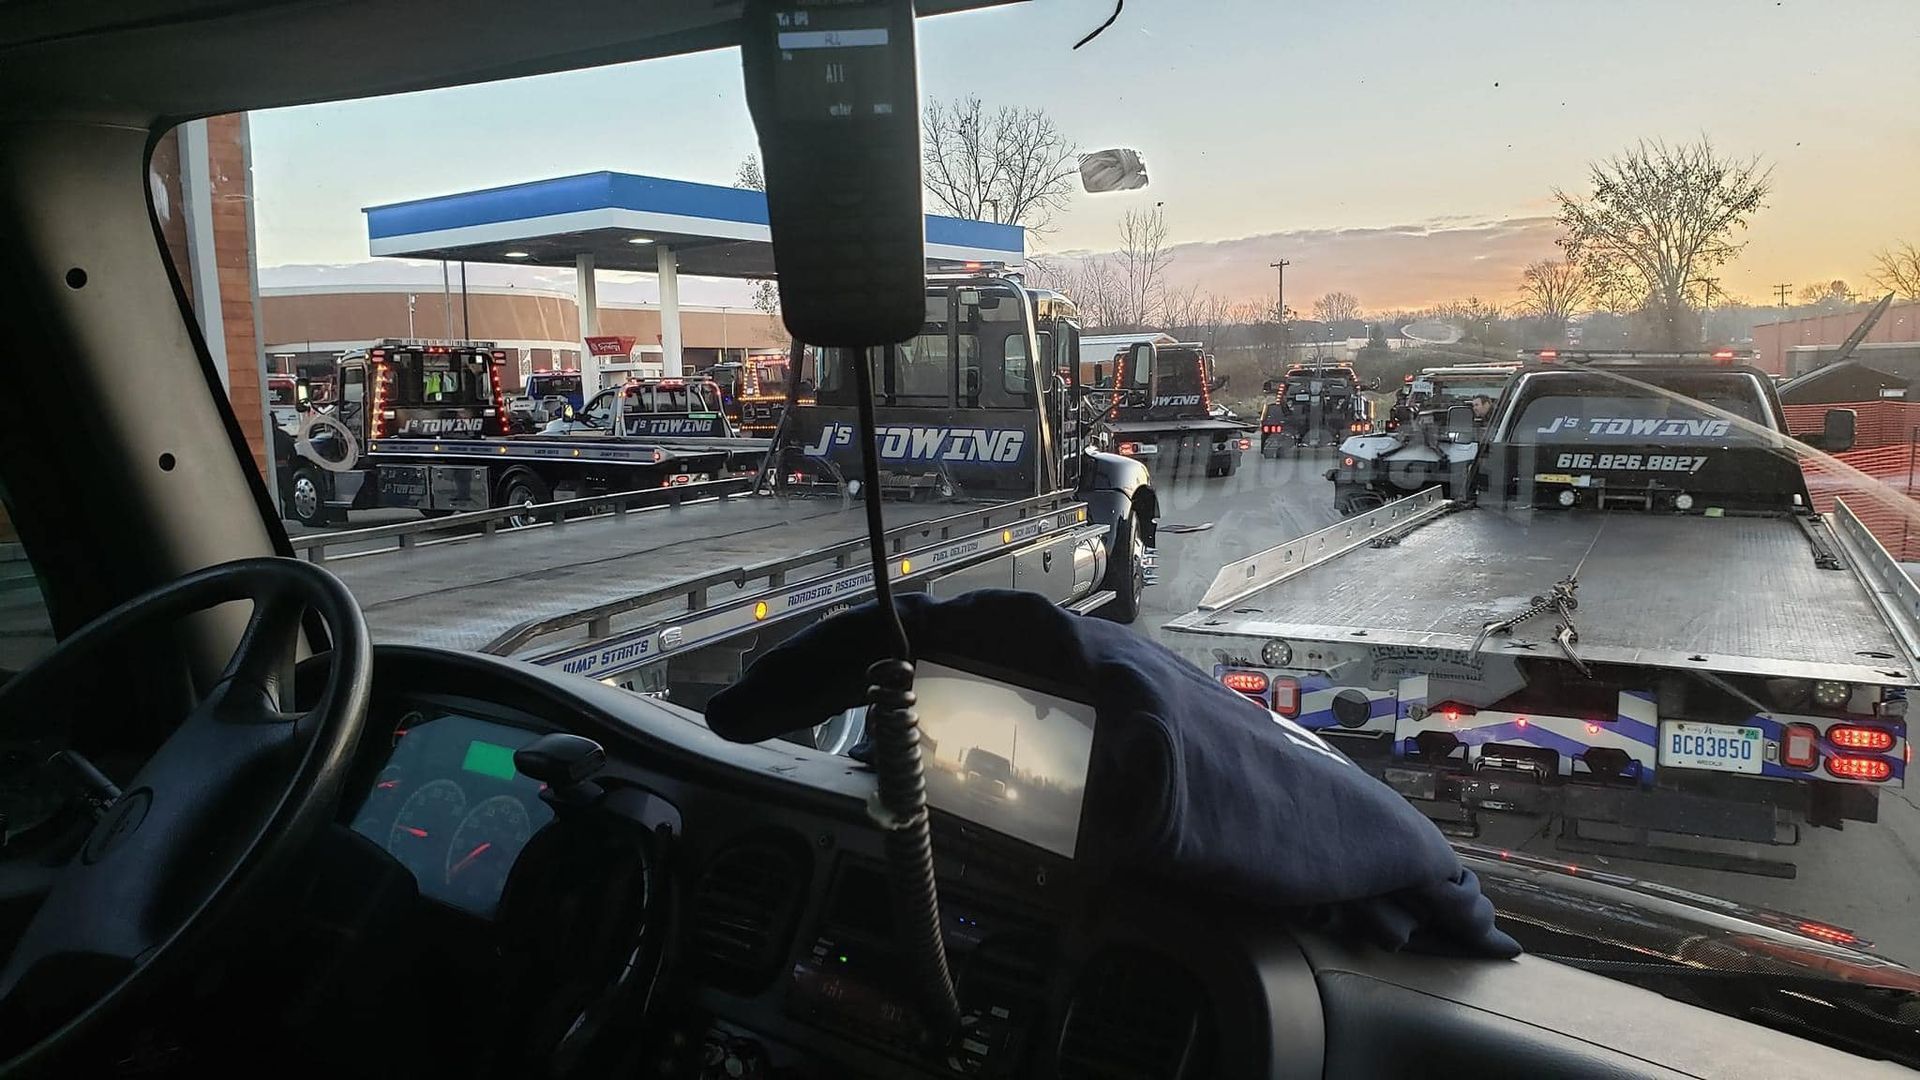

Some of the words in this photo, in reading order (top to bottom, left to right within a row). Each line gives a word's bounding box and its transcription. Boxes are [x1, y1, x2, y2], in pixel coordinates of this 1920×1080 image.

[422, 418, 484, 433] TOWING
[650, 419, 713, 433] TOWING
[1589, 417, 1731, 437] TOWING
[1556, 453, 1708, 473] 616.826.8827
[788, 584, 833, 607] ROADSIDE
[835, 572, 874, 593] ASSISTANC
[600, 639, 649, 665] STARTS
[1672, 734, 1751, 760] BC83850
